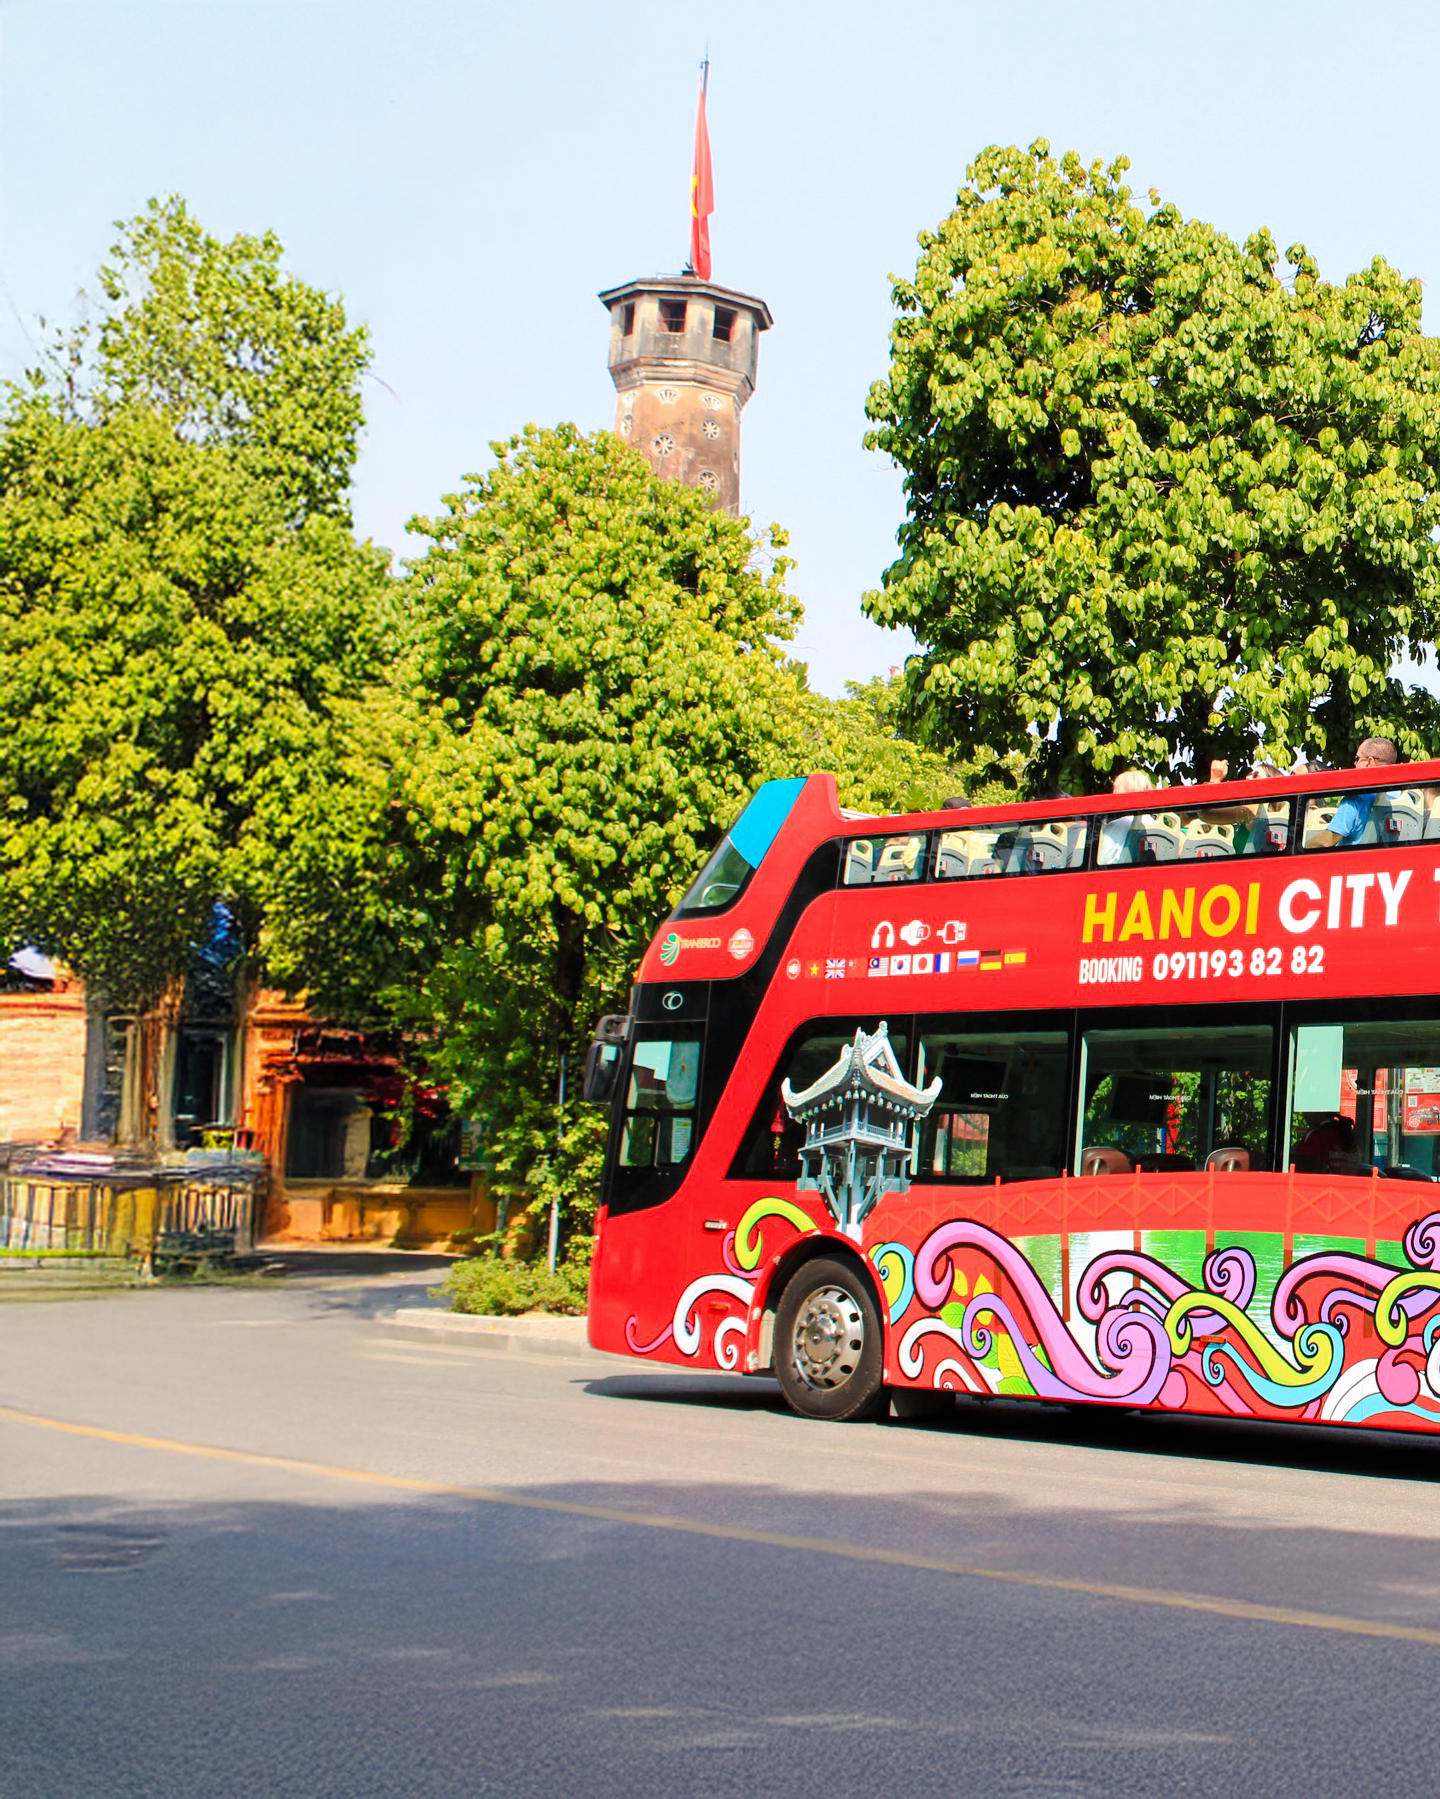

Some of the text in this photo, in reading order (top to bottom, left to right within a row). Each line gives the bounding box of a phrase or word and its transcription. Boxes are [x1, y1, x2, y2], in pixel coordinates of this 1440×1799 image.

[1082, 882, 1261, 944] HANOI
[1278, 869, 1413, 935] CITY
[1078, 945, 1325, 985] BOOKING 091193 82 82
